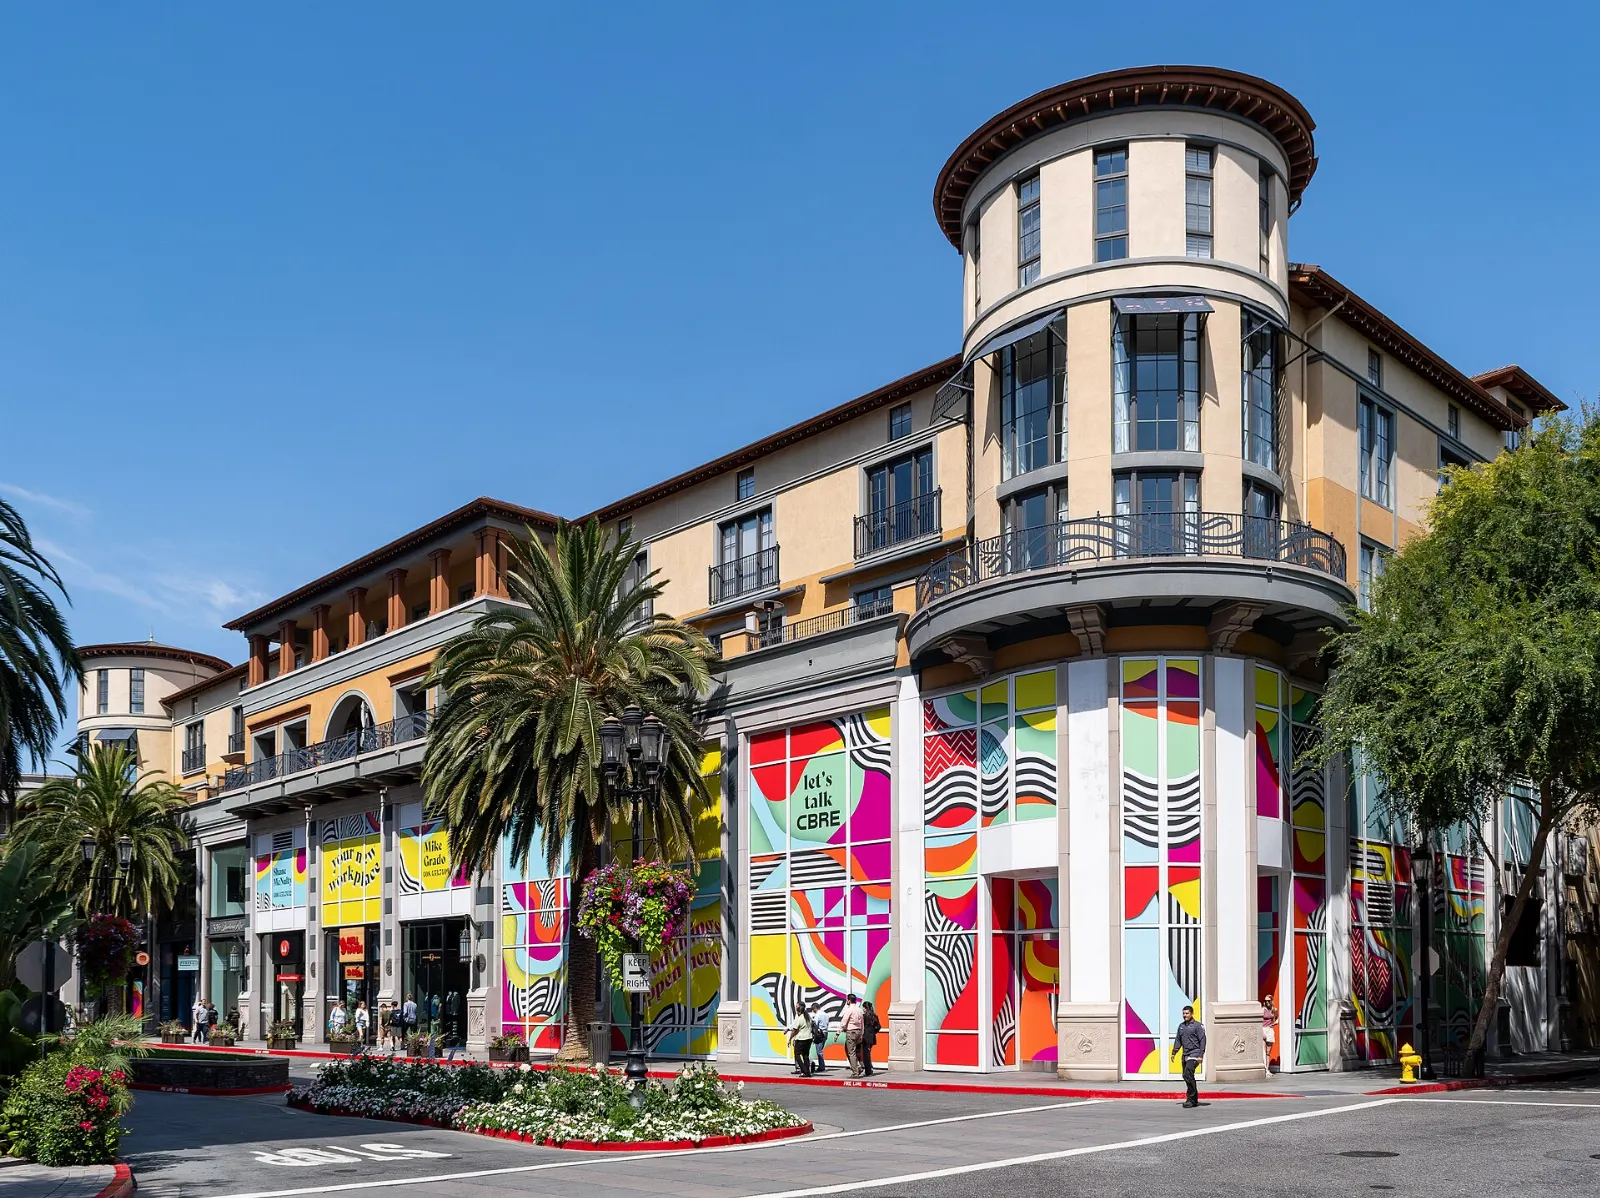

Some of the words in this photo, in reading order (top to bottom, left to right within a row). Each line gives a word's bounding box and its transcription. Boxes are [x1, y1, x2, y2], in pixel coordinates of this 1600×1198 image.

[804, 771, 832, 790] let's
[804, 791, 832, 809] talk
[797, 810, 841, 831] CBRE
[424, 840, 442, 852] Mike
[331, 849, 354, 874] your
[423, 853, 446, 867] Grado
[328, 862, 381, 891] workplace
[628, 959, 647, 967] KEEP
[626, 979, 649, 988] RIGHT
